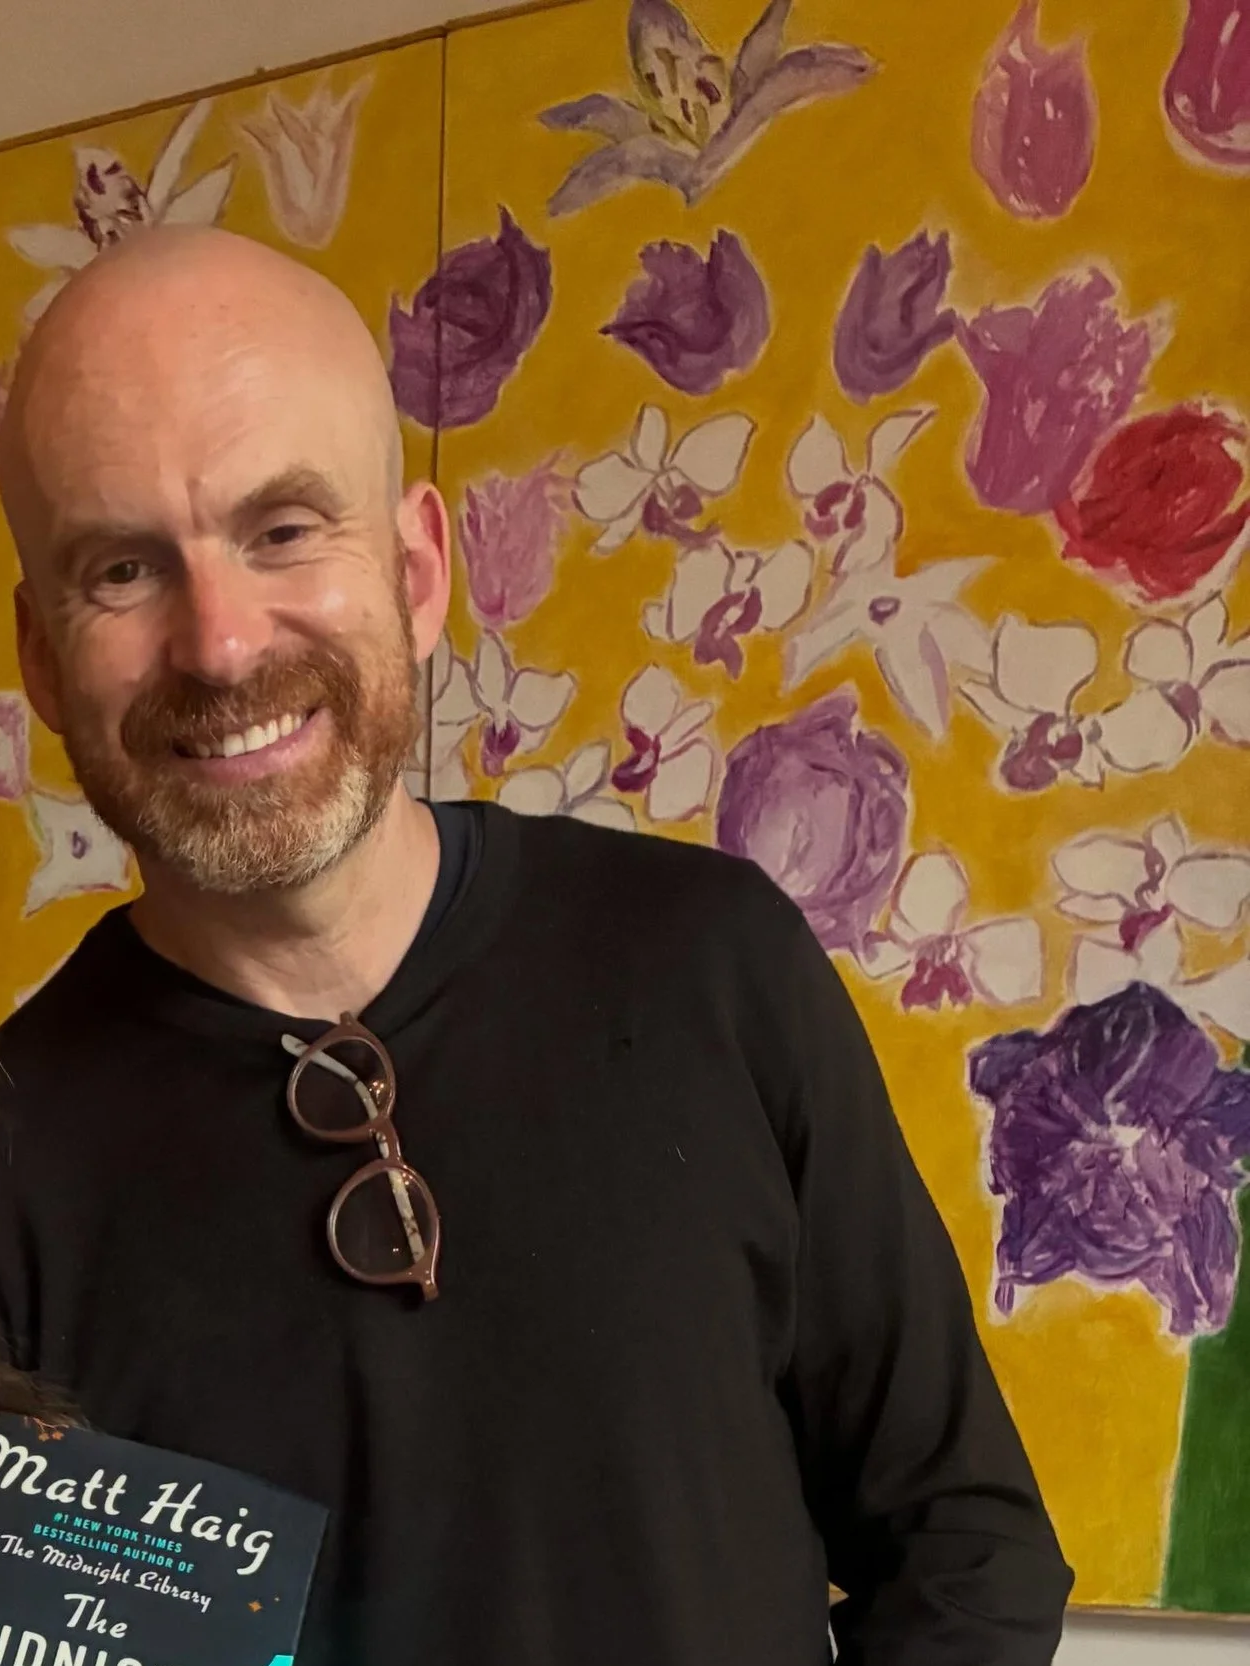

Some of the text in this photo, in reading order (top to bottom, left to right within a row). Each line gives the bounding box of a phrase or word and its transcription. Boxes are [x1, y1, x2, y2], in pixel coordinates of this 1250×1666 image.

[33, 1523, 195, 1574] BESTSELLING AUTHOR OF
[73, 1516, 102, 1532] NEW
[106, 1524, 138, 1542] YORK
[144, 1534, 183, 1554] TIMES
[140, 1482, 274, 1576] Haig
[0, 1534, 212, 1613] The Midnight Library
[63, 1593, 129, 1639] The
